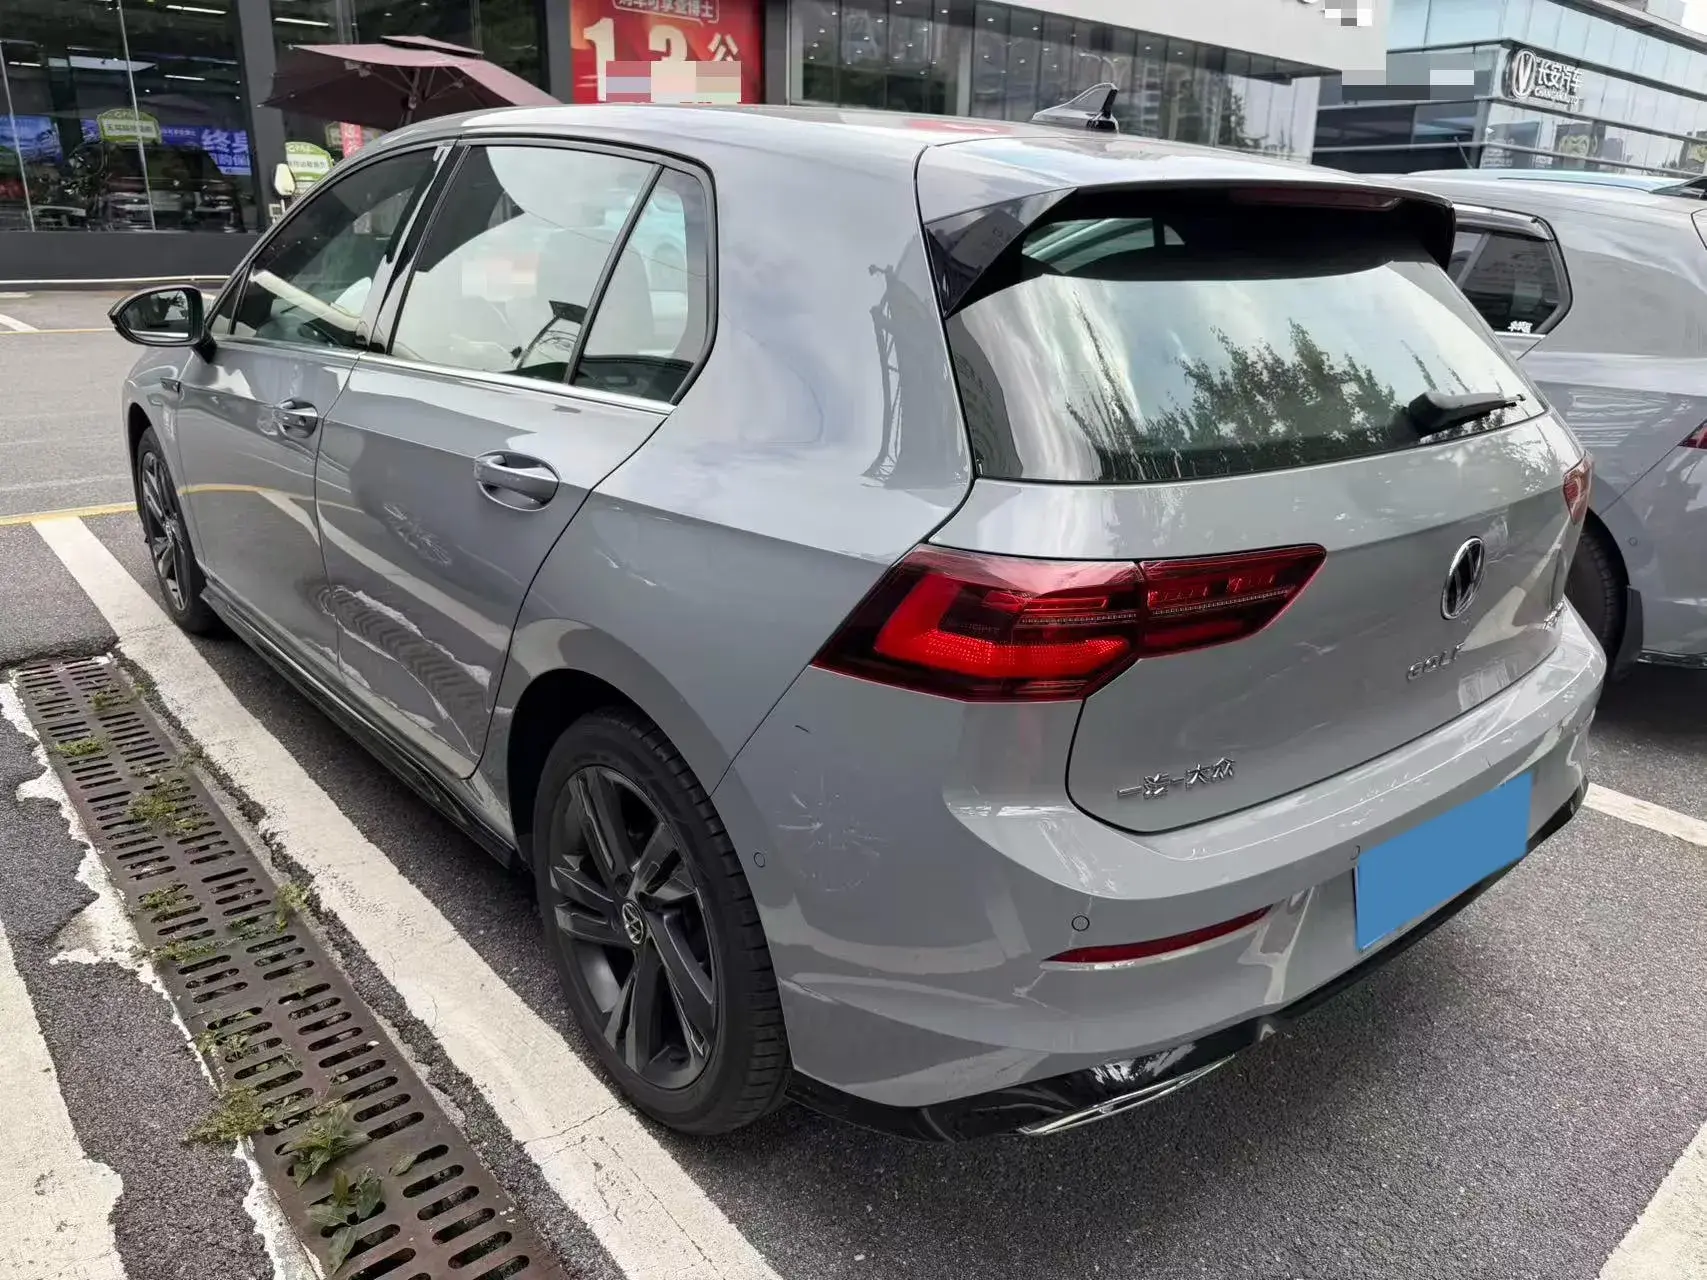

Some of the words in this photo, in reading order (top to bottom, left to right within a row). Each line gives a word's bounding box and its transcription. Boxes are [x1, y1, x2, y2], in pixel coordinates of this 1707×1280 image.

[1537, 57, 1584, 95] 长安汽车
[1406, 642, 1465, 681] GOLF
